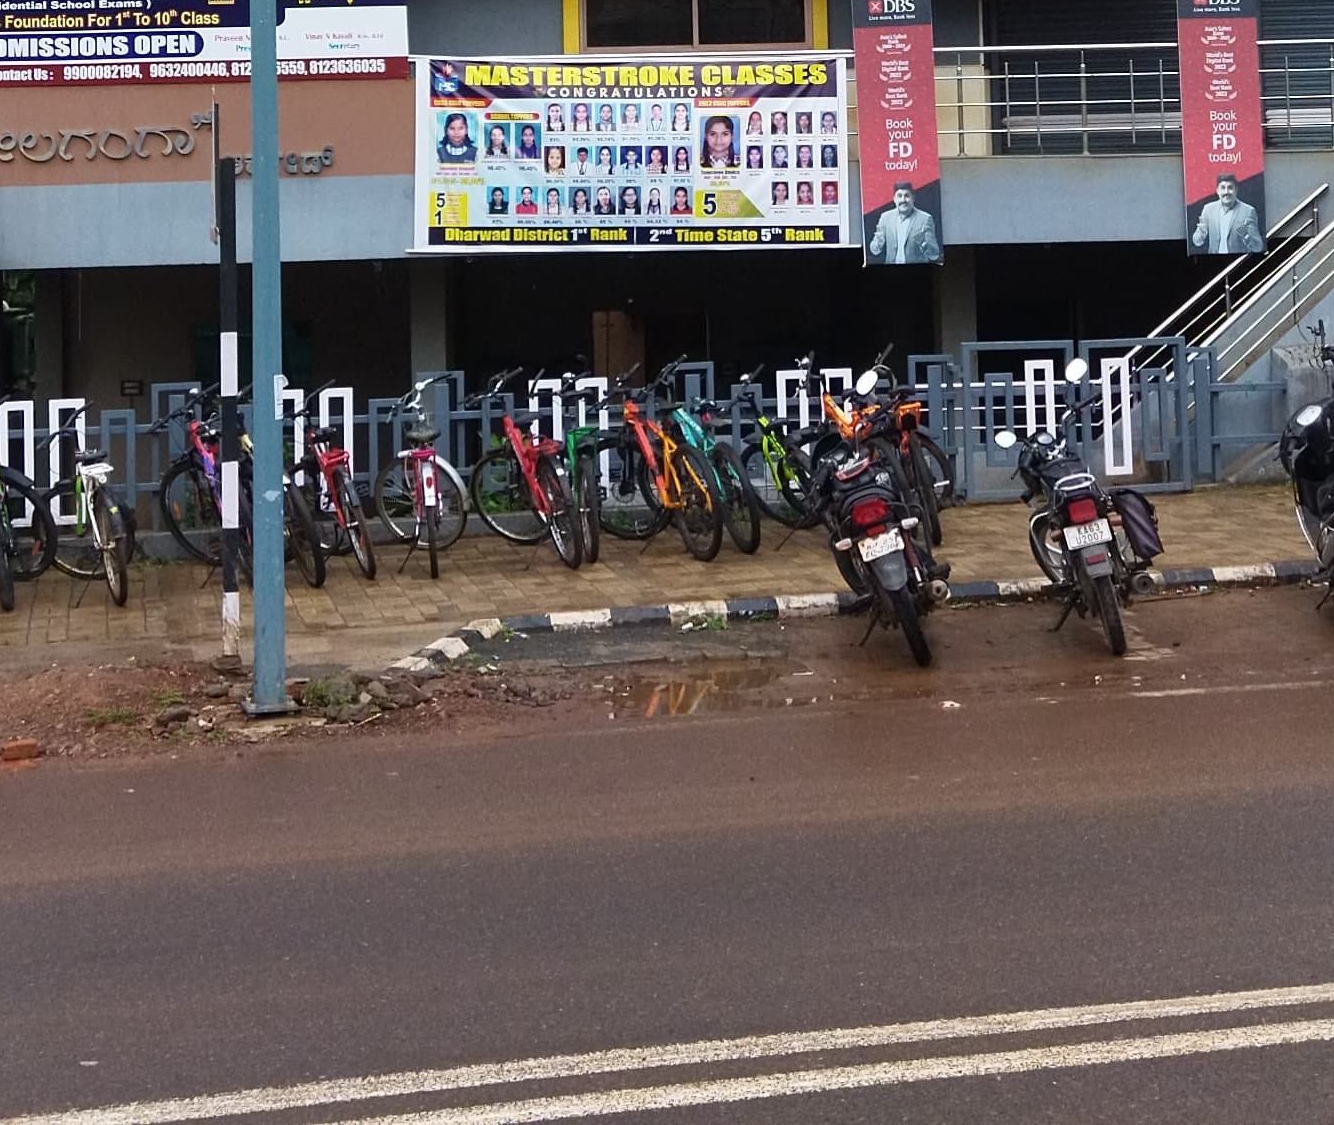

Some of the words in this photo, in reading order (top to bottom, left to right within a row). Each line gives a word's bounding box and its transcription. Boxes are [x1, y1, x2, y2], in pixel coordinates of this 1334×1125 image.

[50, 1, 95, 9] School
[99, 0, 143, 8] Exams
[884, 0, 915, 12] DBS
[4, 15, 84, 28] Foundation
[88, 14, 111, 27] For
[133, 13, 150, 25] To
[181, 13, 219, 25] Class
[134, 34, 196, 55] OPEN
[34, 69, 48, 81] Us
[64, 64, 142, 81] 9900082194,
[150, 60, 230, 78] 9632400446,
[309, 59, 385, 73] 8123636035
[465, 65, 694, 86] MASTERSTROKE
[701, 64, 827, 86] CLASSES
[547, 86, 723, 98] CONGRATULATIONS
[1210, 110, 1237, 122] Book
[886, 119, 913, 130] Book
[1212, 122, 1238, 133] your
[888, 130, 913, 141] your
[1213, 135, 1236, 150] FD
[889, 143, 912, 158] FD
[1208, 151, 1242, 164] today!
[885, 159, 918, 172] today!
[436, 195, 445, 207] 5
[703, 193, 716, 215] 5
[445, 229, 510, 242] Dharwad
[513, 228, 567, 241] District
[571, 228, 587, 240] 1st
[590, 229, 627, 241] Rank
[650, 228, 672, 242] 2nd
[675, 230, 714, 242] Time
[717, 229, 757, 241] State
[761, 228, 782, 241] 5th
[785, 229, 824, 241] Rank
[1078, 523, 1100, 534] KA63
[1076, 531, 1103, 544] U2007
